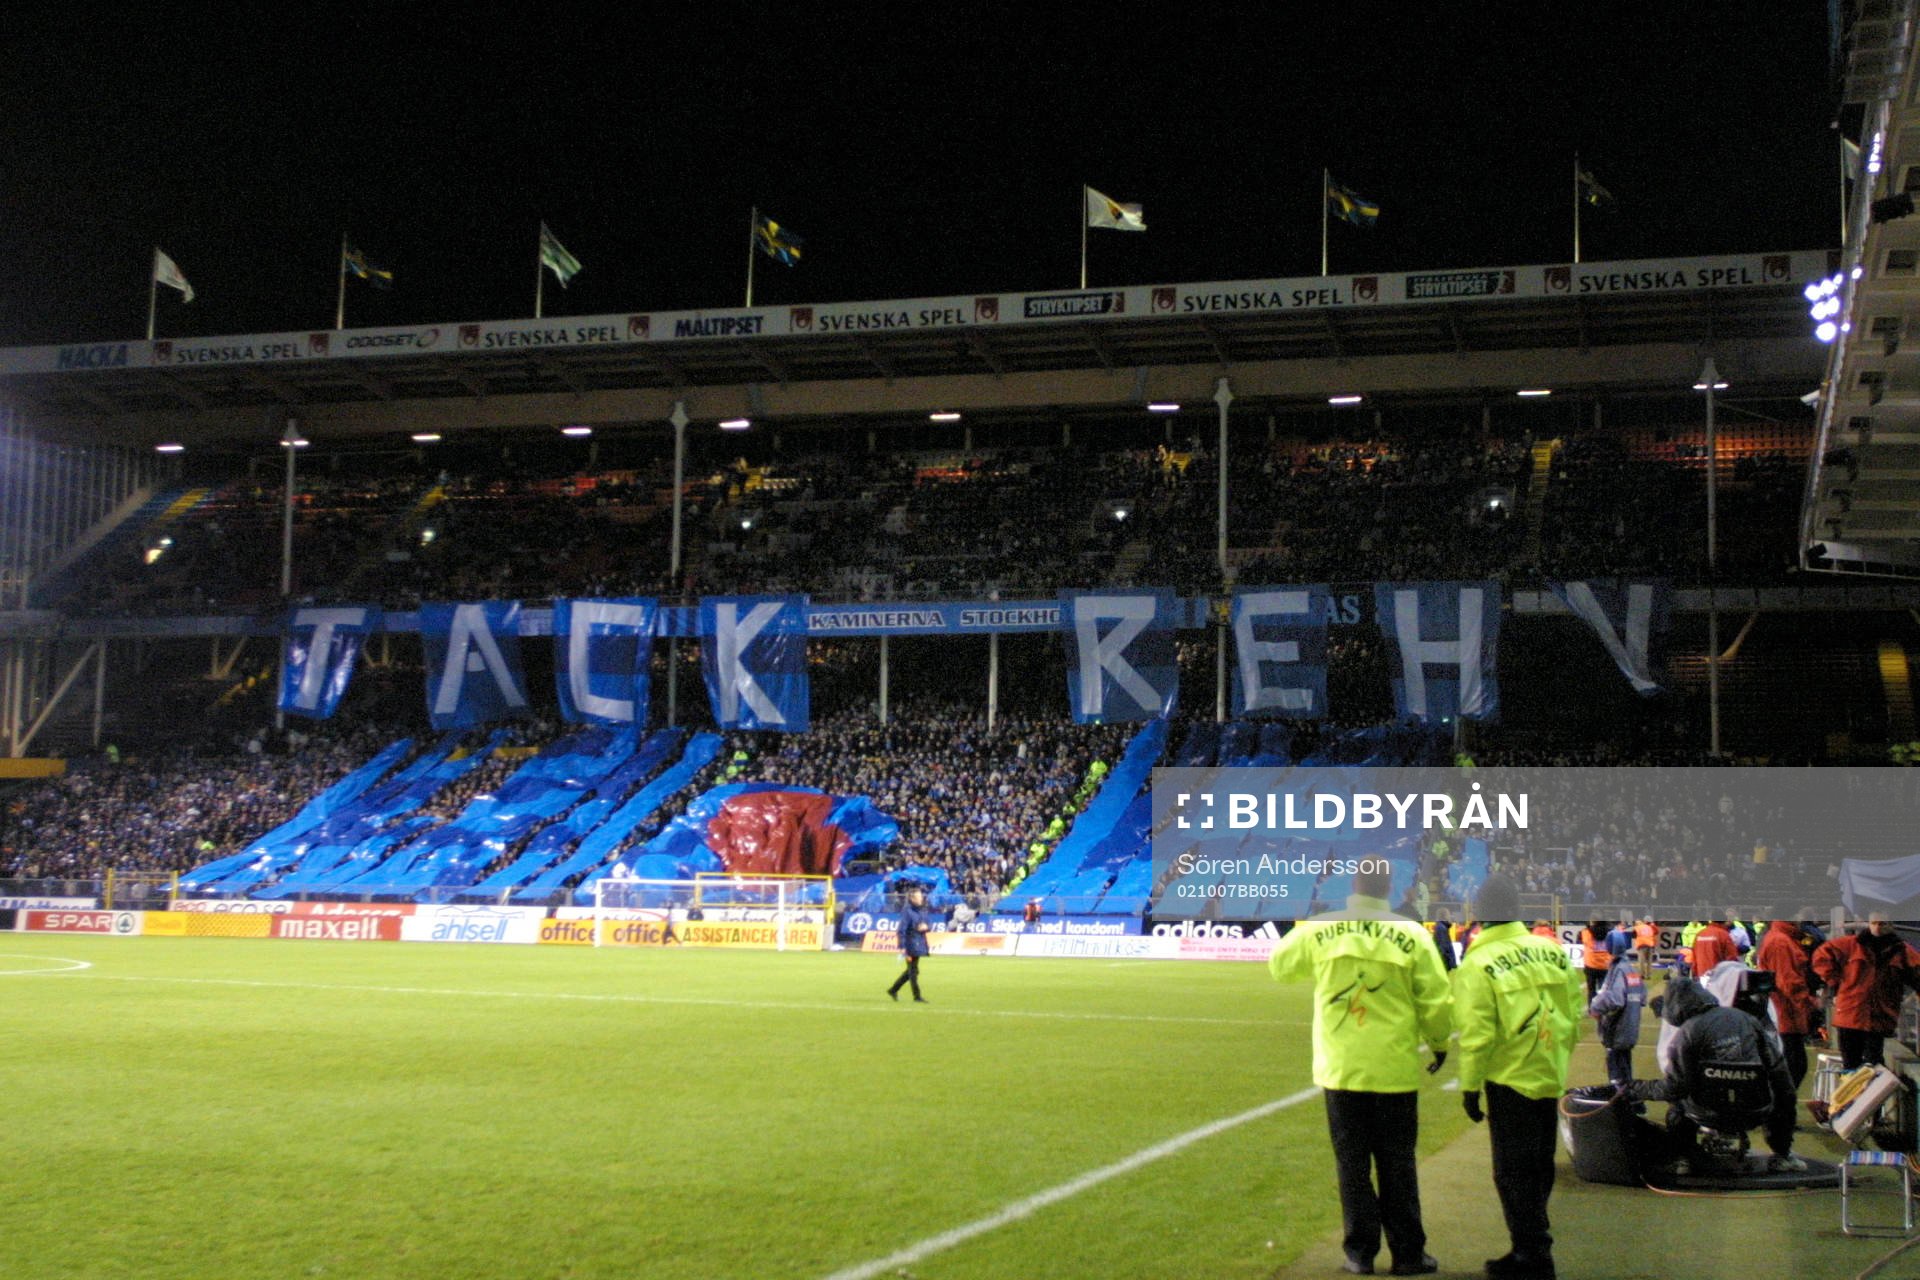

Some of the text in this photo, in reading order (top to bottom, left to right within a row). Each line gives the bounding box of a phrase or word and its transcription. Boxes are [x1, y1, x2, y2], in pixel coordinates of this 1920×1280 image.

[1412, 279, 1488, 297] STRYKTIPSET
[1578, 268, 1753, 292] SVENSKA SPEL
[1029, 296, 1104, 314] STRYKTIPSET
[1183, 290, 1344, 312] SVENSKA SPEL
[819, 308, 967, 331] SVENSKA SPEL
[484, 326, 621, 348] SVENSKA SPEL
[177, 343, 301, 363] SVENSKA SPEL
[809, 610, 945, 630] KAMINERNA
[43, 913, 112, 929] SPAR
[280, 917, 378, 939] maxell
[431, 918, 508, 940] ahlsell
[1066, 920, 1125, 934] kondom!
[1152, 920, 1243, 939] adidas
[613, 922, 671, 944] offic
[1703, 1067, 1758, 1081] CANAL+
